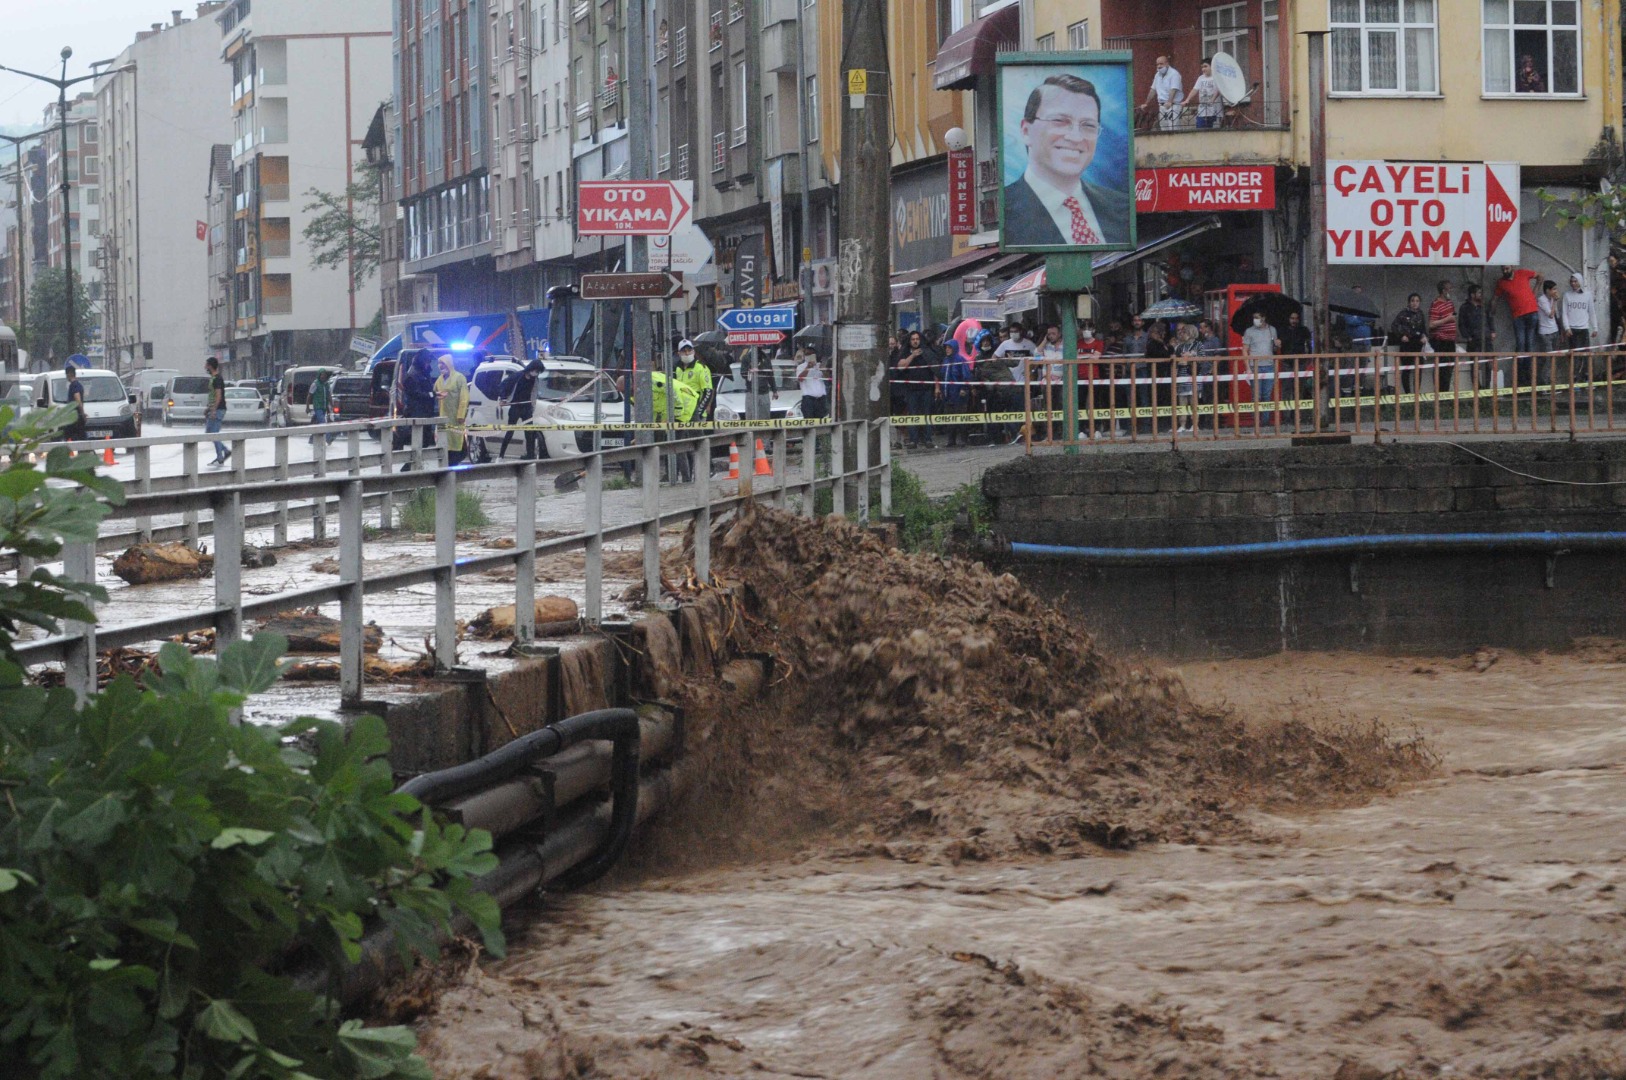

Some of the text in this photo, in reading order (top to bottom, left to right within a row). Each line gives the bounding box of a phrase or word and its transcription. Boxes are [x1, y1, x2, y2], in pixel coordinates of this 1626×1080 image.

[1168, 172, 1262, 188] KALENDER
[603, 189, 647, 202] OTO
[957, 160, 968, 223] KÜNEFE
[1188, 189, 1263, 204] MARKET
[582, 208, 668, 222] YIKAMA
[1370, 198, 1446, 227] OTO
[1327, 230, 1480, 258] YIKAMA
[736, 312, 788, 326] Otogar
